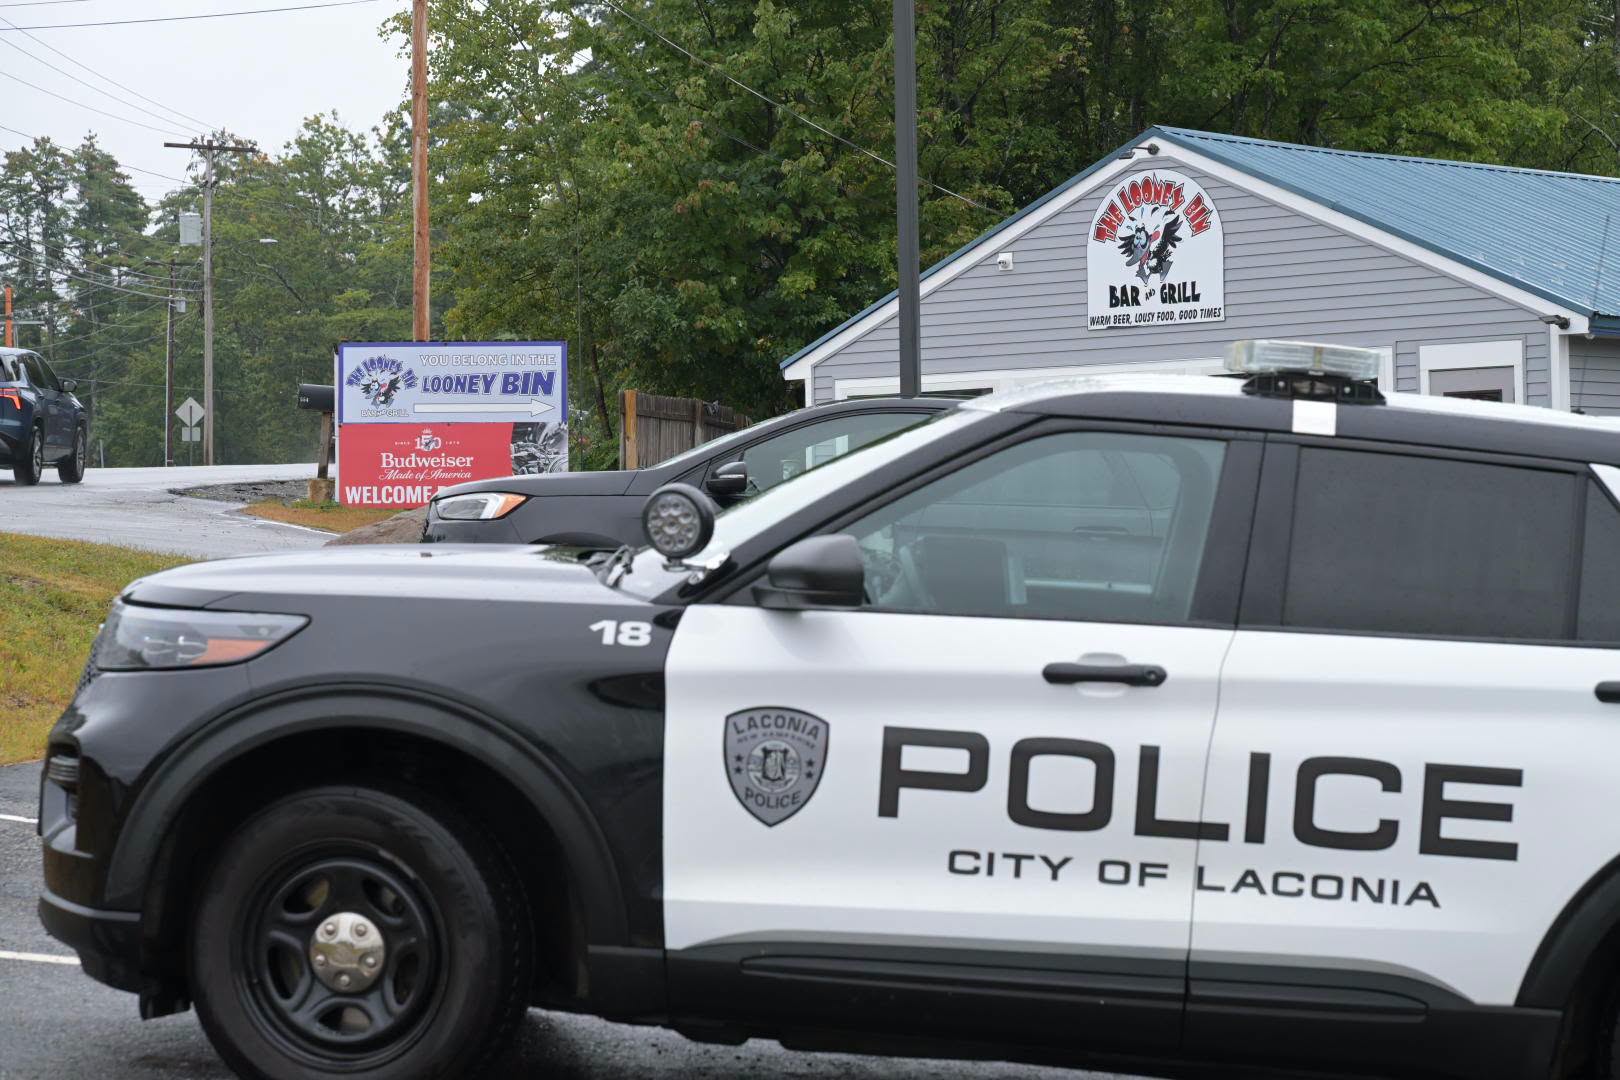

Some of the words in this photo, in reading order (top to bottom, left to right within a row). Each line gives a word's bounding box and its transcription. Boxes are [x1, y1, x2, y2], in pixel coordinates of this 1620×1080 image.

[1093, 200, 1125, 243] THE
[1117, 172, 1185, 215] LOONEY
[1183, 192, 1213, 237] BIN
[1108, 284, 1141, 308] BAR
[1145, 289, 1156, 301] AND
[1160, 281, 1201, 304] GRILL
[1090, 315, 1112, 326] WARM
[1113, 313, 1132, 325] BEER,
[1135, 312, 1155, 323] LOUSY
[1157, 310, 1176, 321] FOOD,
[1179, 309, 1198, 320] GOOD
[1200, 307, 1222, 319] TIMES
[420, 354, 449, 366] YOU
[452, 354, 507, 366] BELONG
[510, 354, 526, 365] IN
[529, 353, 556, 365] THE
[421, 372, 499, 395] LOONEY
[501, 370, 557, 396] BIN
[380, 452, 474, 467] Budweiser
[379, 469, 414, 480] Made
[415, 469, 429, 481] of
[427, 468, 472, 480] America
[345, 485, 433, 504] WELCOME
[588, 620, 652, 646] 18
[733, 714, 819, 740] LACONIA
[744, 787, 802, 808] POLICE
[878, 725, 1523, 862] POLICE
[948, 850, 1073, 881] CITY
[1099, 860, 1169, 887] OF
[1196, 865, 1440, 909] LACONIA
